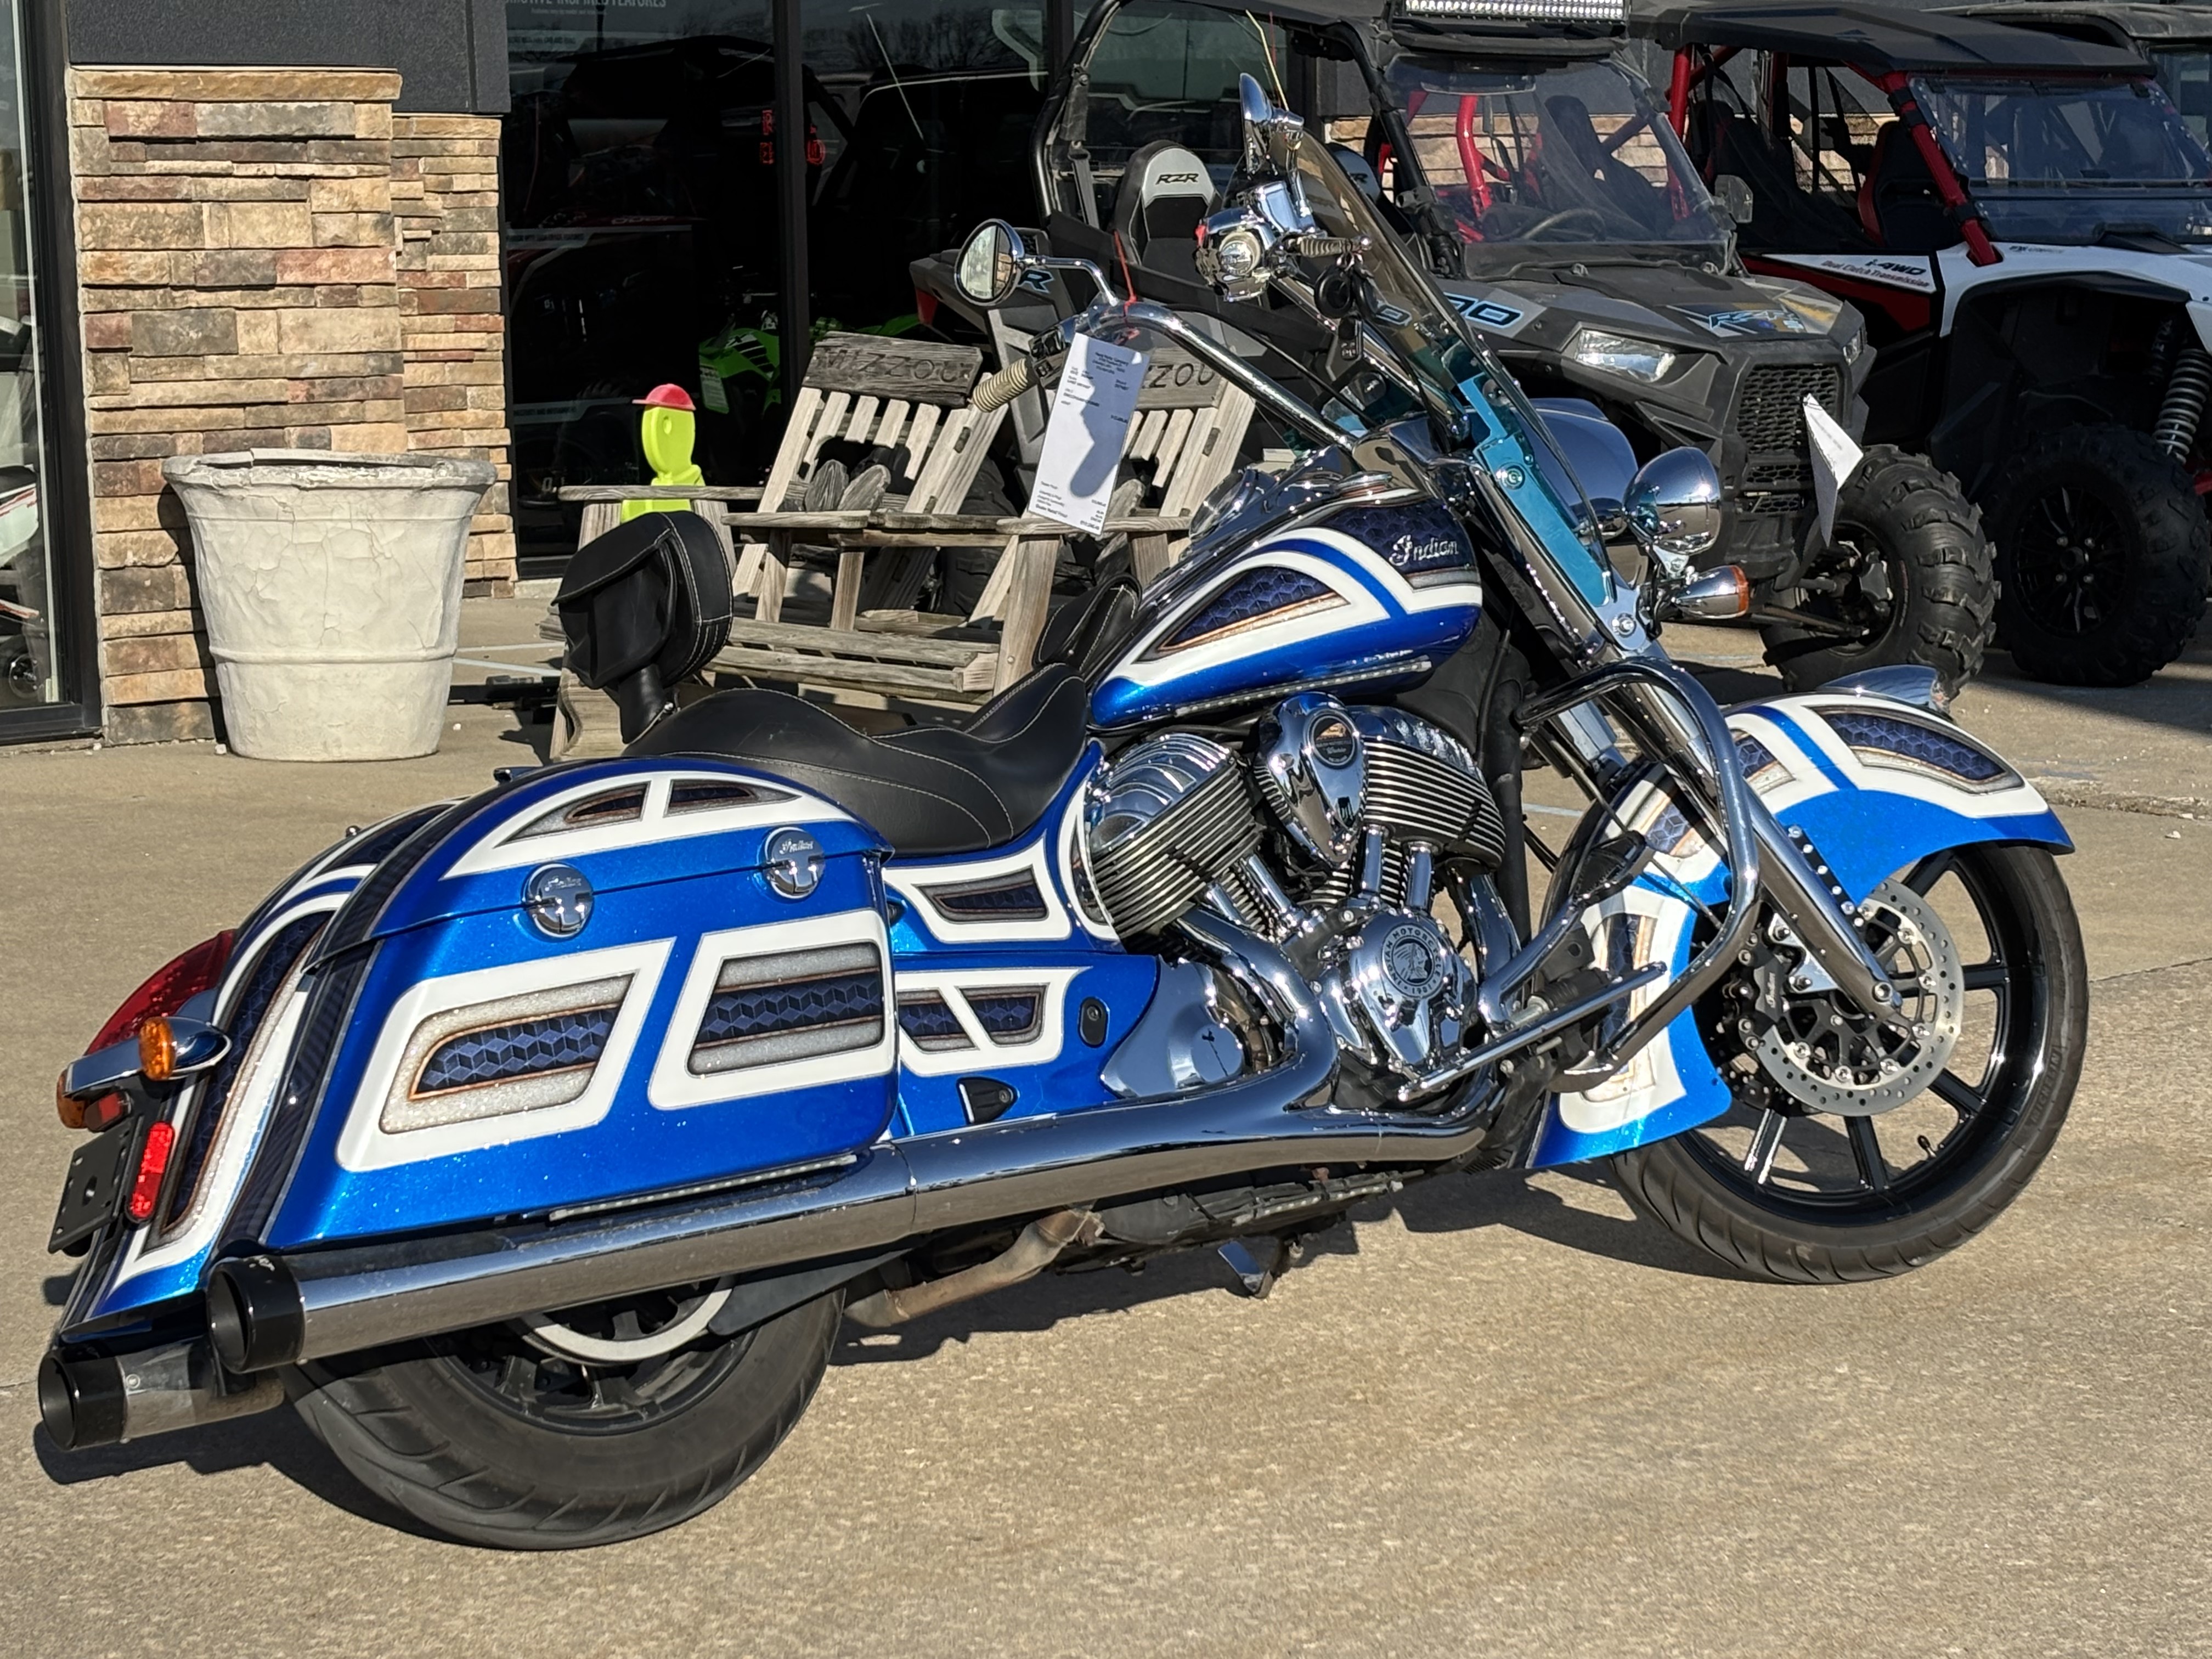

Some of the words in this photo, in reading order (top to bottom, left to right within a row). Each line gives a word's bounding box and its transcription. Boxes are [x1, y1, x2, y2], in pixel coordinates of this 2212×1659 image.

[1155, 173, 1199, 185] RZR
[1821, 260, 1844, 269] Dual
[1842, 264, 1871, 274] Clutch
[1871, 269, 1930, 287] Transmission
[1143, 363, 1215, 388] ZOU
[1389, 534, 1459, 567] Indian
[1384, 940, 1402, 985] INDIAN
[1392, 927, 1442, 977] MOTORCYCLE
[2030, 1047, 2063, 1123] MICHELIN
